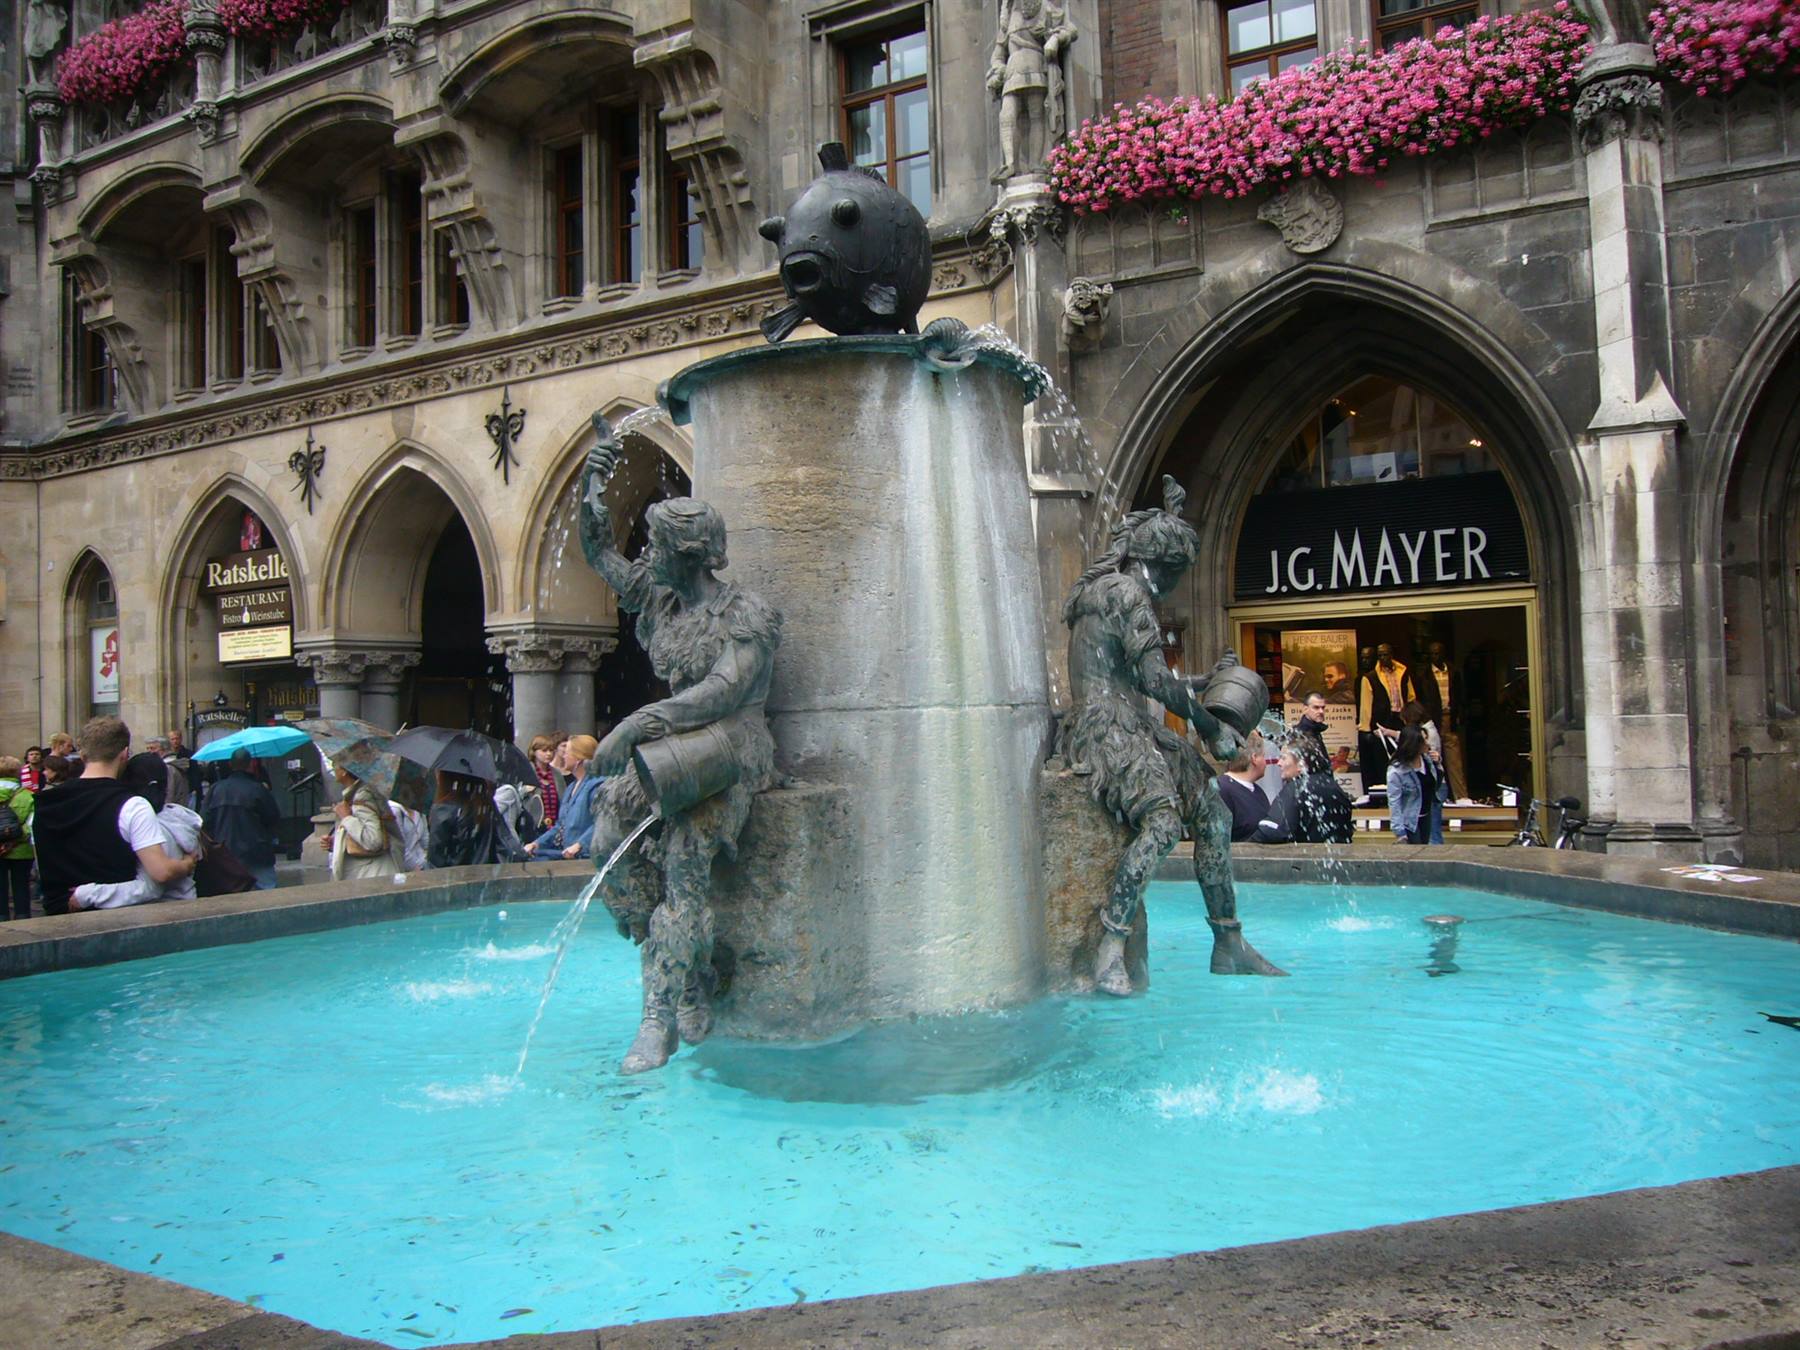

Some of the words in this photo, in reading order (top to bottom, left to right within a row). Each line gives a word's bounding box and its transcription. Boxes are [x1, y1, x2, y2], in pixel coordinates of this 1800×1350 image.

[1265, 546, 1323, 593] J.G.
[1329, 526, 1491, 589] MAYER
[207, 553, 289, 587] Ratskelle
[221, 591, 286, 609] RESTAURANT
[222, 613, 242, 625] Bistro
[250, 608, 285, 622] Weinstube
[1320, 634, 1348, 644] BAUER
[197, 710, 247, 724] Ratskeller
